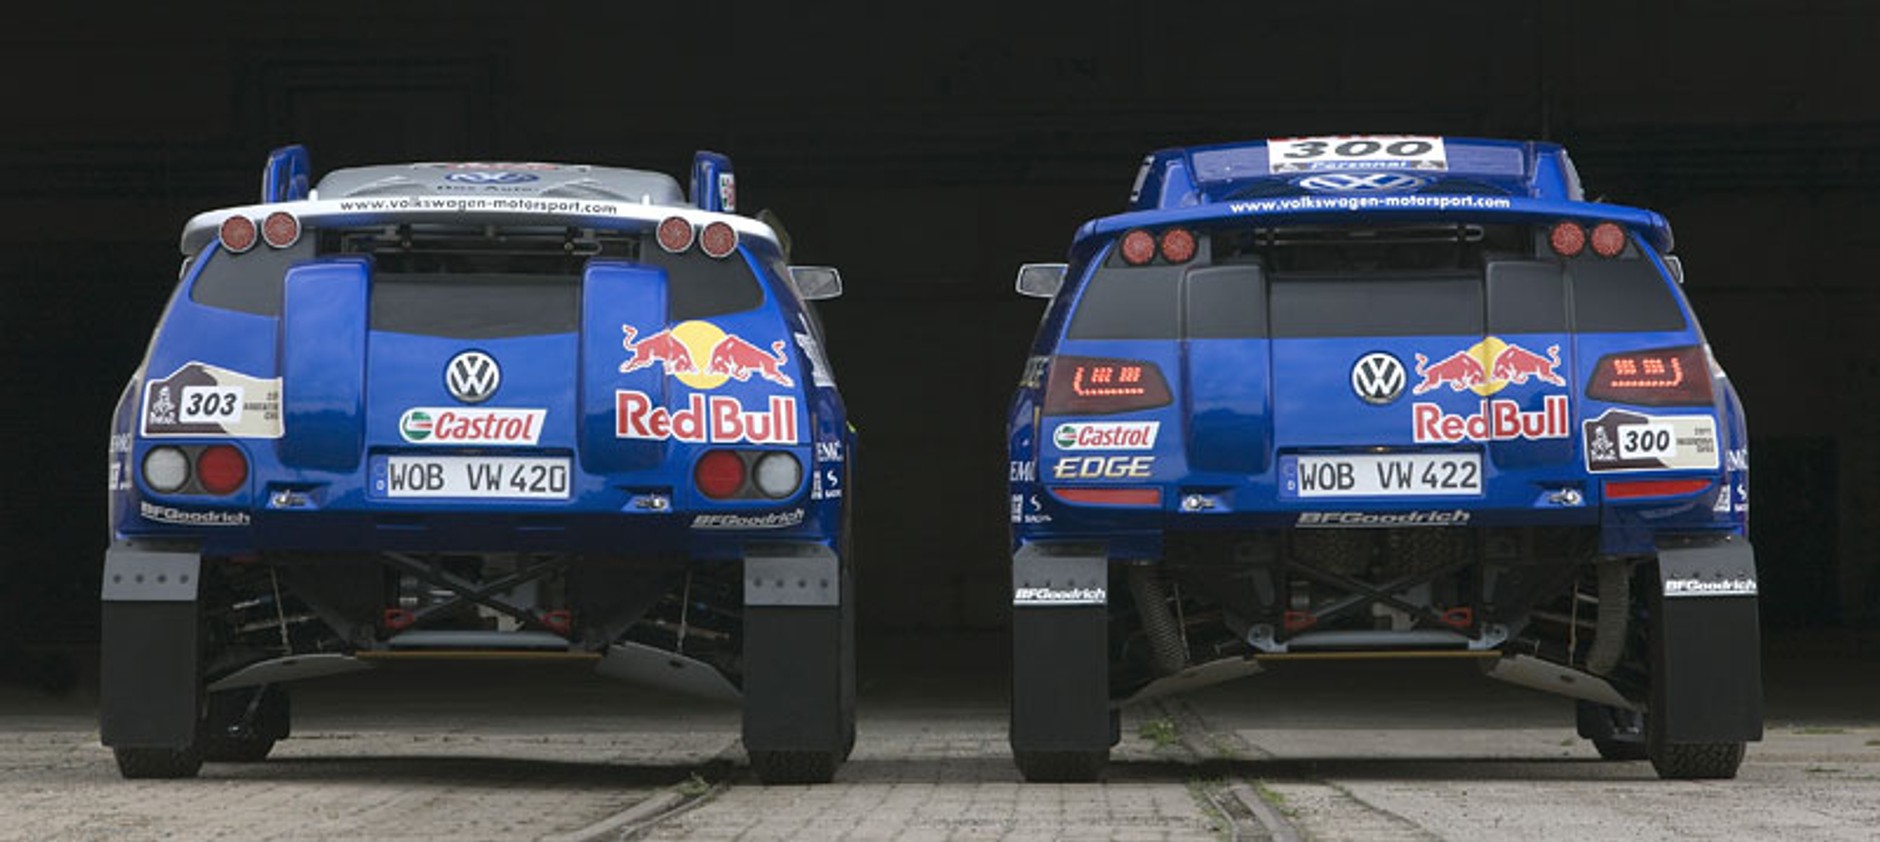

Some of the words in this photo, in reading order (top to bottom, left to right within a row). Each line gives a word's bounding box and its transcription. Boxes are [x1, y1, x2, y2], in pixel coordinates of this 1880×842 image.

[1283, 140, 1434, 159] 300
[340, 197, 617, 215] www.volkswagen-motorsport.com
[1230, 195, 1511, 213] www.volkswagen-motorsport.com
[186, 393, 237, 416] 303
[434, 411, 534, 441] Castrol
[615, 389, 706, 443] Red
[709, 394, 798, 444] Bull
[1413, 400, 1490, 443] Red
[1491, 395, 1569, 440] Bull
[1077, 425, 1151, 447] Castrol
[1624, 429, 1670, 453] 300
[389, 462, 445, 492] WOB
[466, 462, 503, 492] VW
[509, 464, 567, 493] 420
[1053, 456, 1155, 478] EDGE
[1299, 461, 1355, 491] WOB
[1376, 461, 1415, 491] VW
[1421, 460, 1479, 489] 422
[140, 501, 251, 526] BFGoodrich
[692, 508, 805, 528] BFGoodrich
[1297, 509, 1471, 527] BFGoodrich
[1015, 587, 1106, 602] BFGoodrich
[1665, 578, 1758, 594] BFGoodrich
